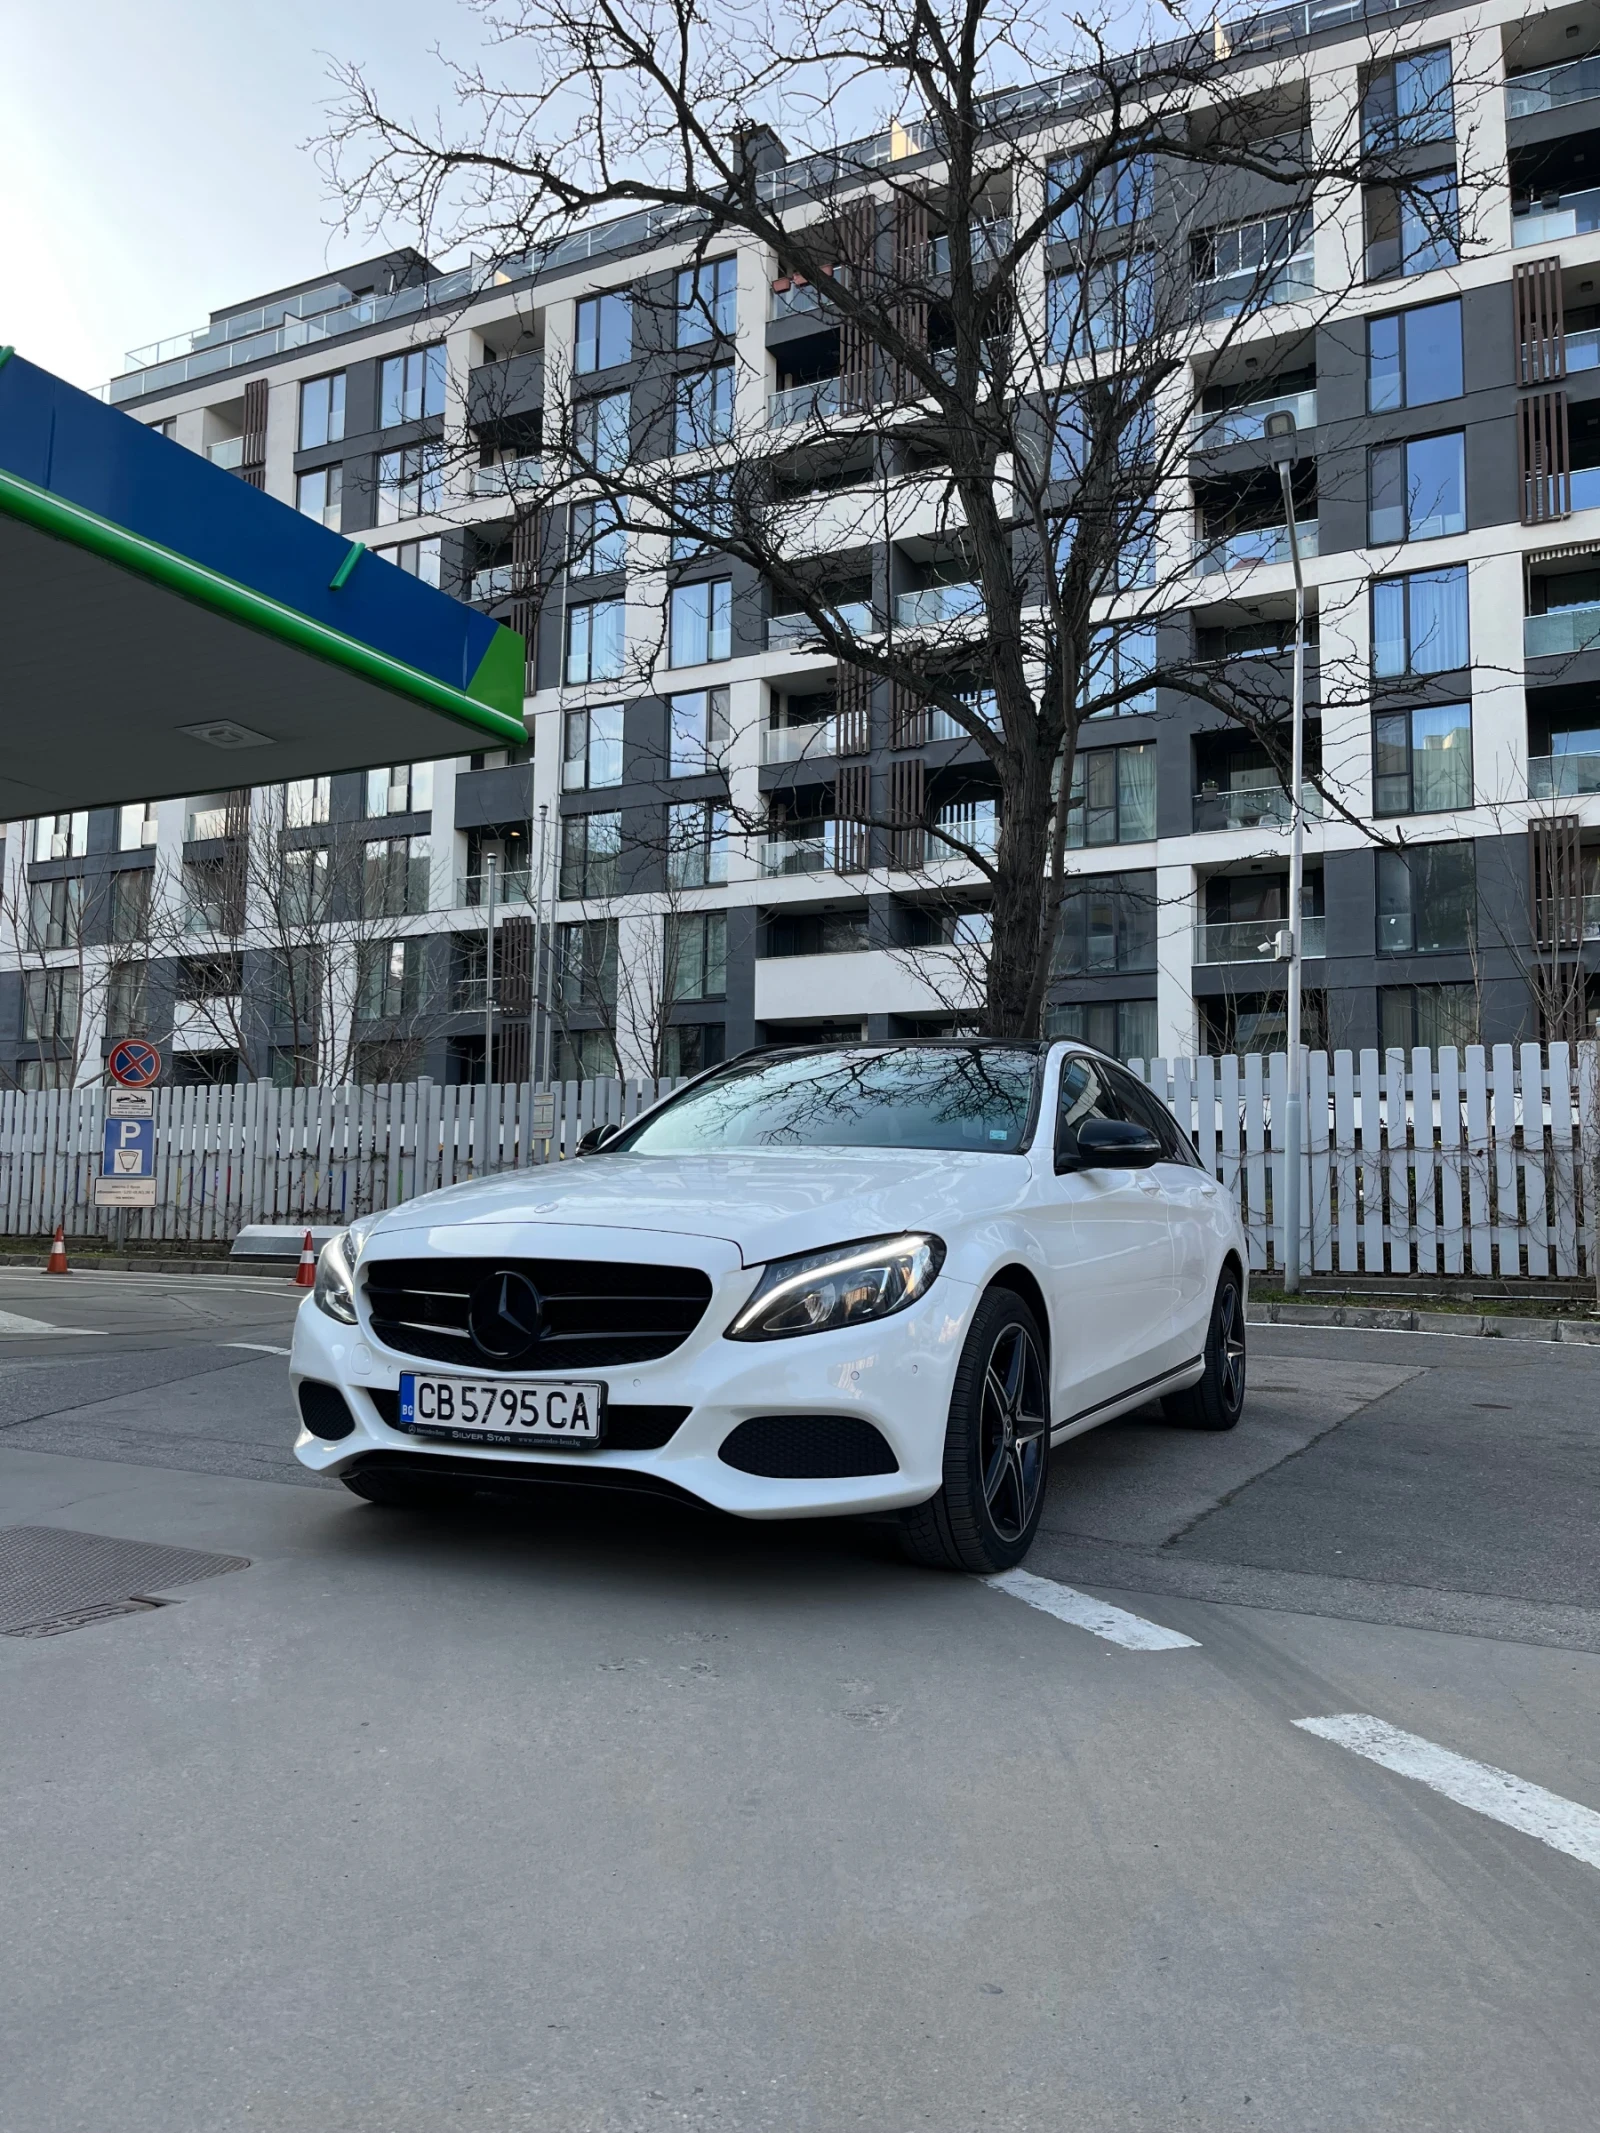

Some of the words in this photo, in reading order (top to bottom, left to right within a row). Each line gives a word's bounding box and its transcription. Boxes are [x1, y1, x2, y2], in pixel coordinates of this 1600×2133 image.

[120, 1121, 141, 1148] P
[402, 1404, 414, 1416] BG
[452, 1430, 484, 1440] SILVER
[487, 1433, 511, 1443] STAR
